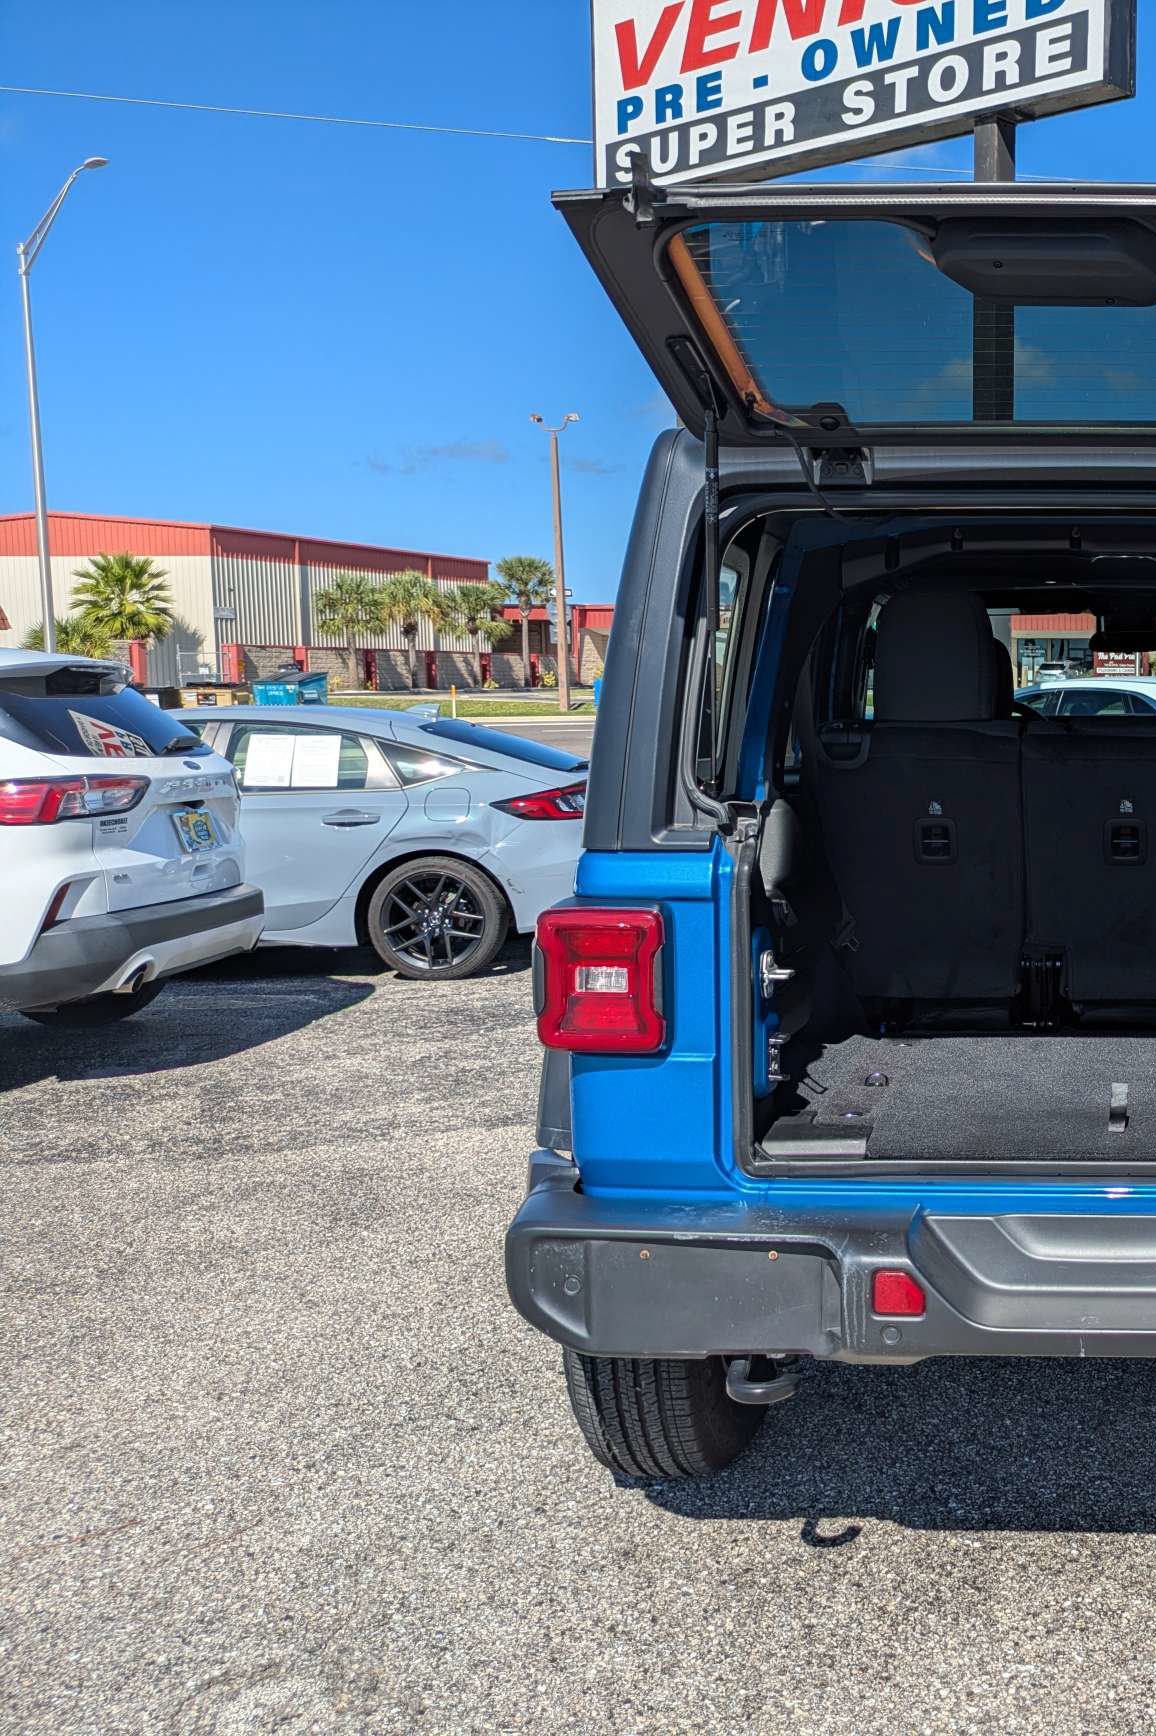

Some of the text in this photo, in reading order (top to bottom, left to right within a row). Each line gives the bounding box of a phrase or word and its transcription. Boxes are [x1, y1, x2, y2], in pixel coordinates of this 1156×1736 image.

[615, 0, 924, 91] VEN
[615, 22, 1073, 183] SUPER STORE
[617, 70, 723, 135] PRE
